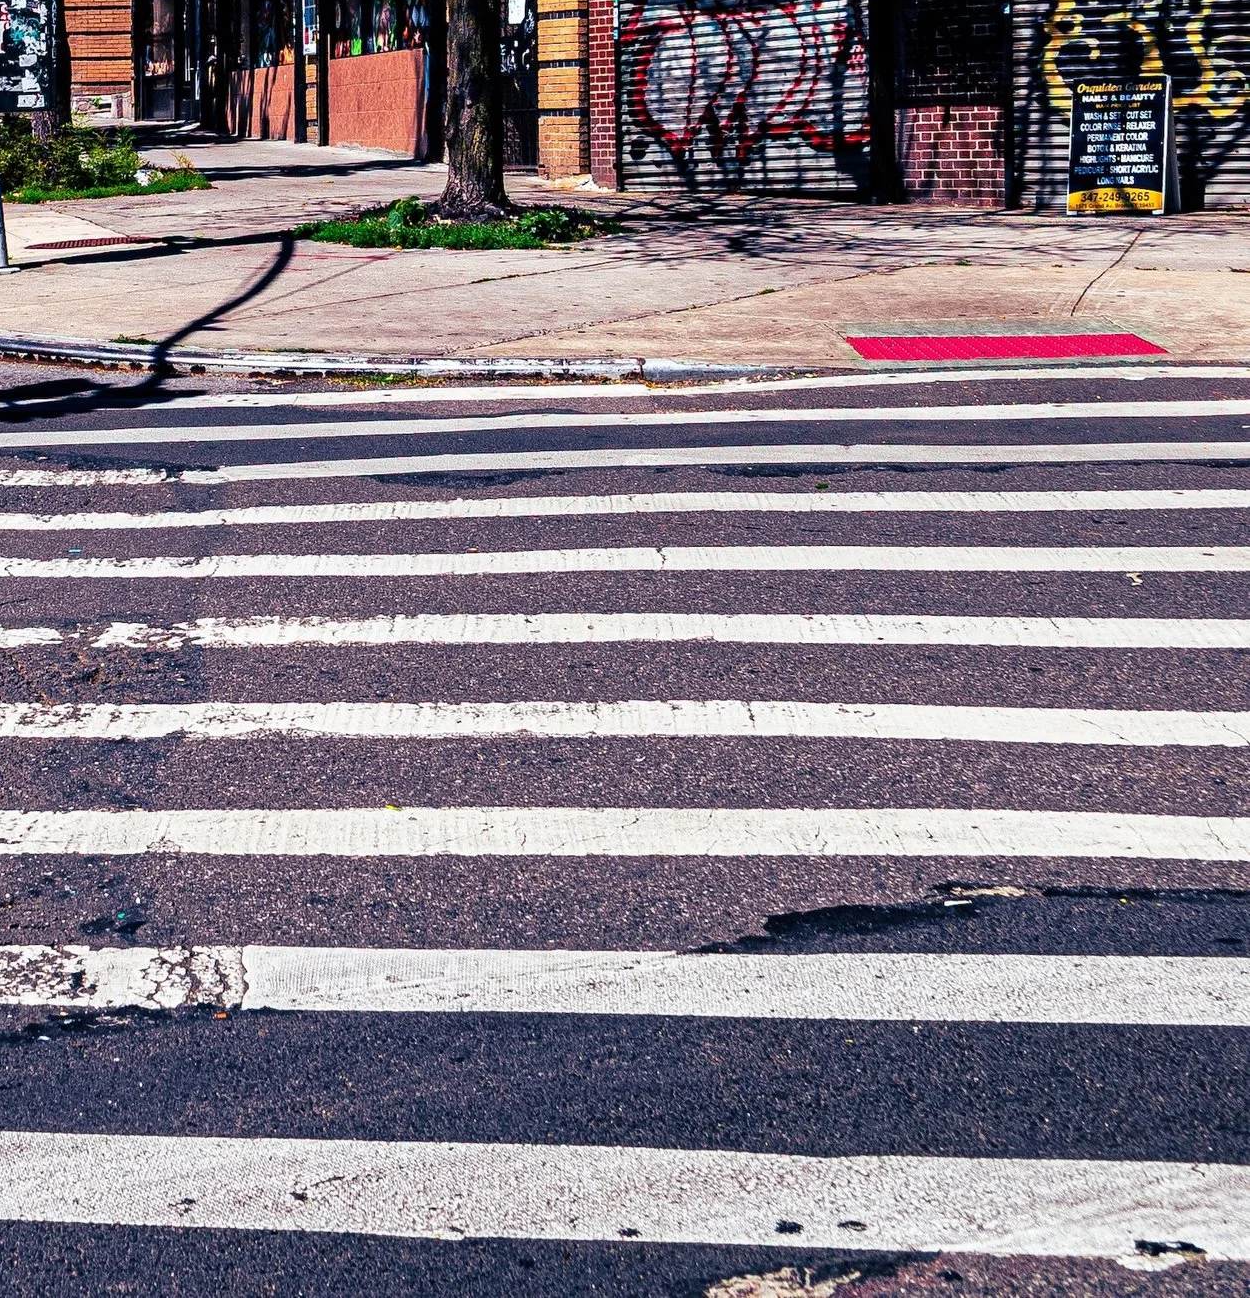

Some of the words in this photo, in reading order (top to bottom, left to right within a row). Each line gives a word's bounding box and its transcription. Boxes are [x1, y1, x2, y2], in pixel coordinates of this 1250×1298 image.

[1120, 93, 1155, 101] BEAUTY
[1084, 112, 1102, 120] WASH
[1103, 112, 1108, 120] &
[1109, 111, 1121, 120] SET
[1126, 111, 1139, 119] CUT
[1140, 110, 1152, 119] SET
[1080, 123, 1102, 132] COLOR
[1126, 121, 1156, 130] RELAXER
[1126, 132, 1148, 141] COLOR
[1115, 143, 1146, 152] KERATINA
[1121, 154, 1154, 162] MANICURE
[1074, 166, 1104, 174] PEDICURE
[1110, 165, 1130, 174] SHORT
[1131, 165, 1158, 173] ACRYLIC
[1097, 176, 1114, 185] LONG
[1116, 176, 1134, 184] NAILS
